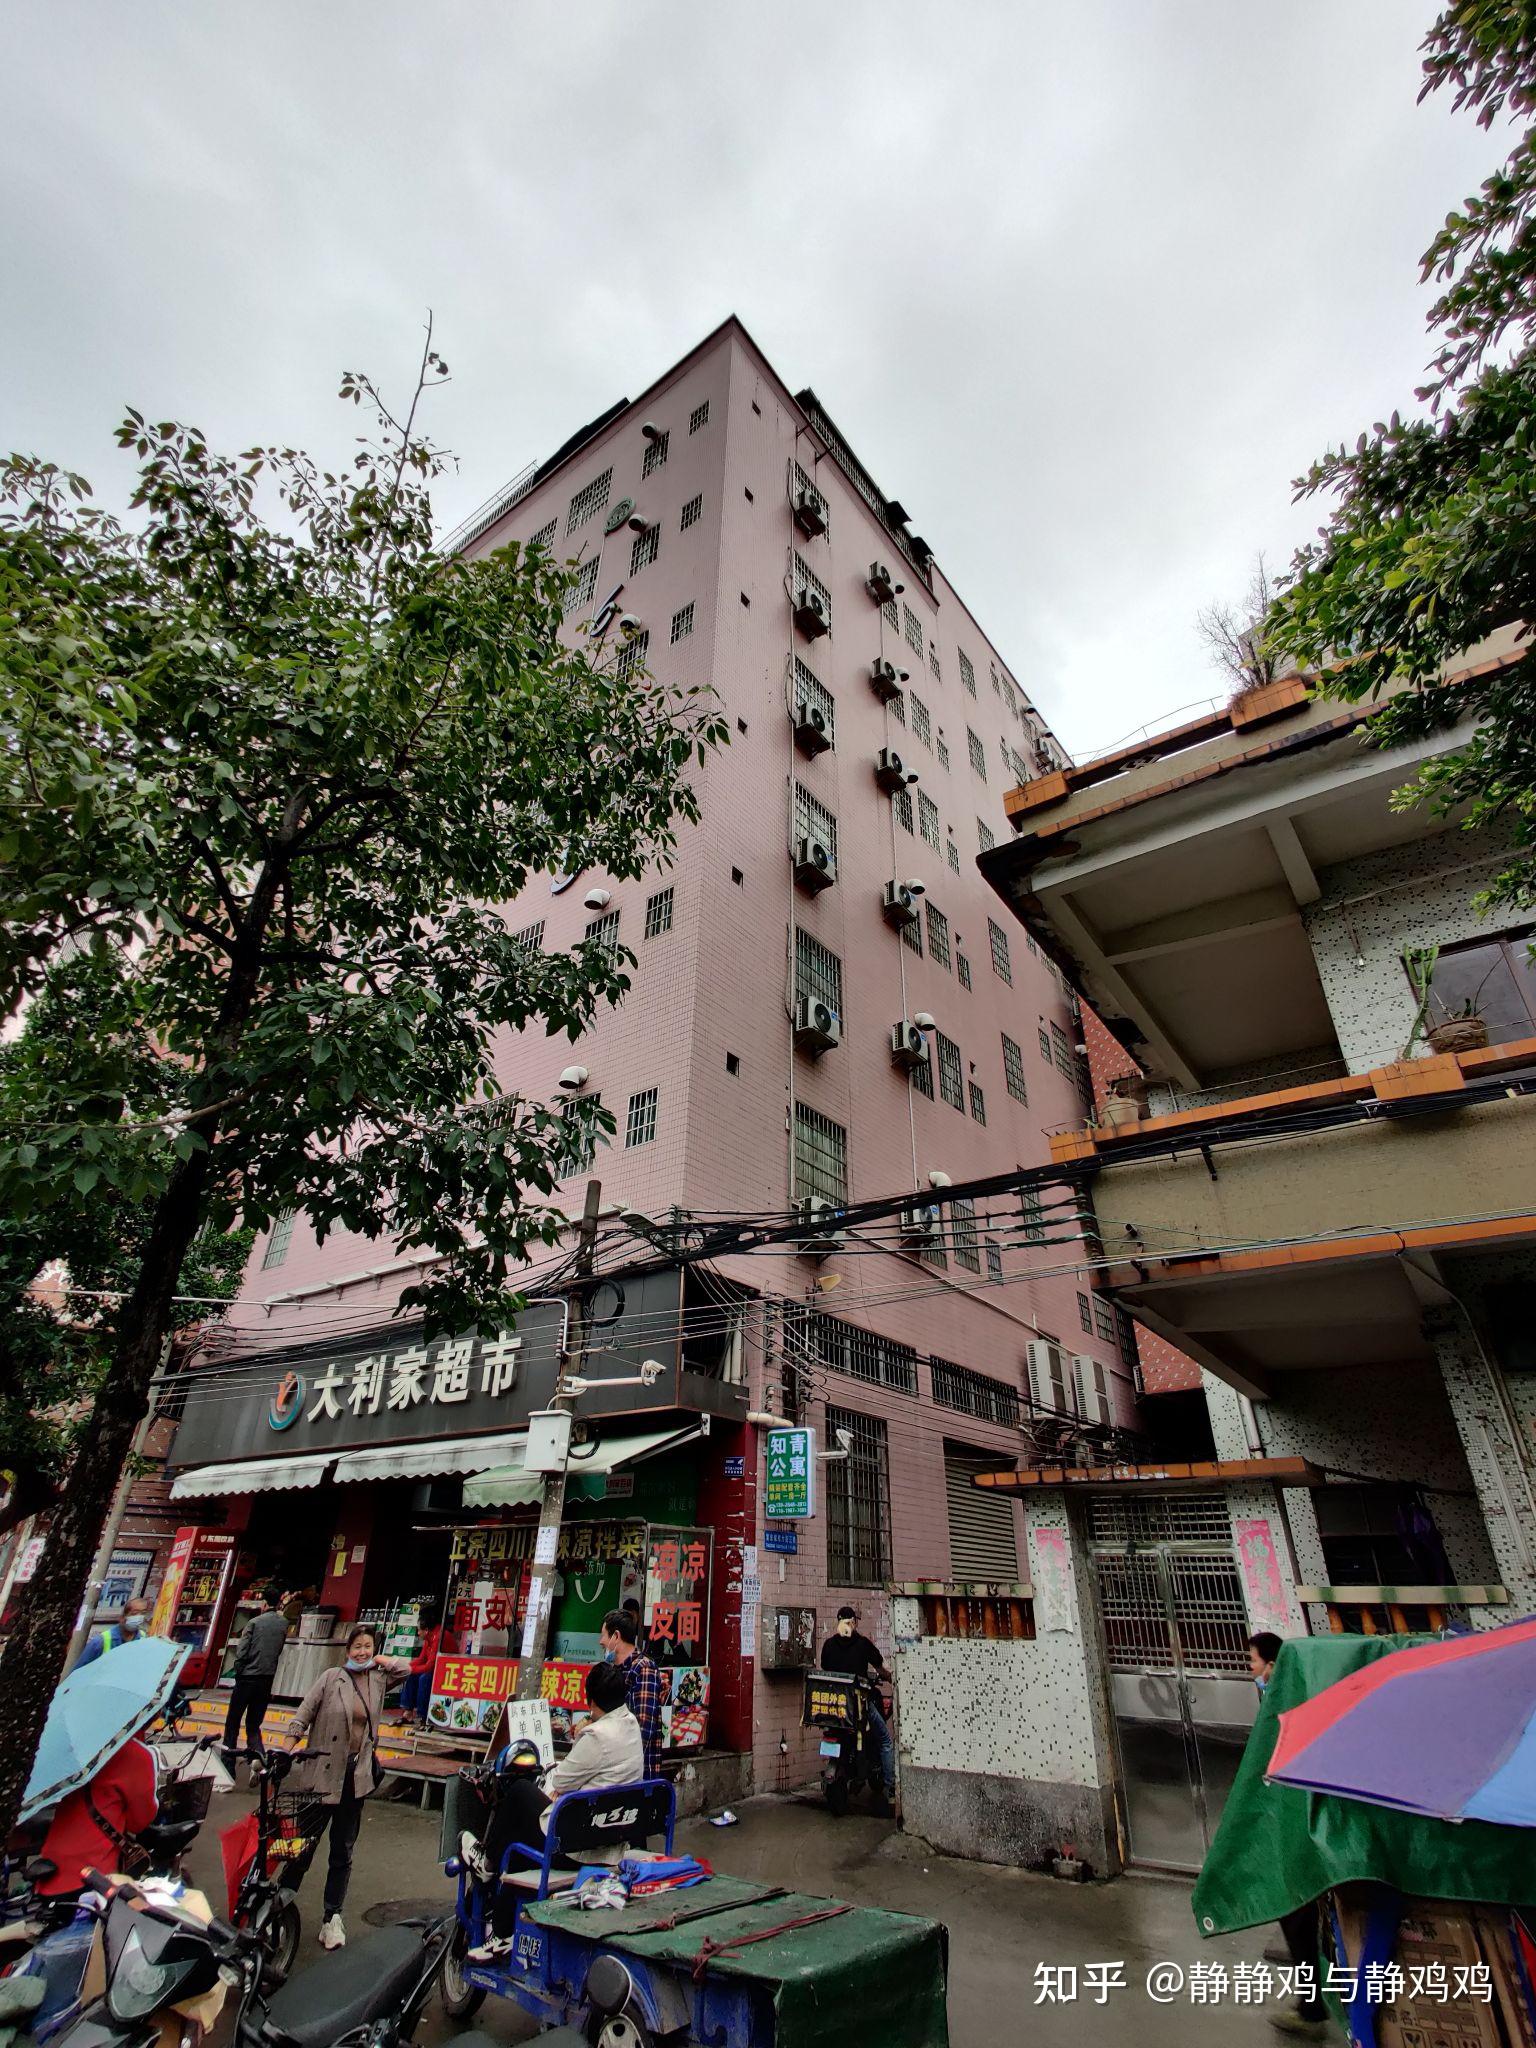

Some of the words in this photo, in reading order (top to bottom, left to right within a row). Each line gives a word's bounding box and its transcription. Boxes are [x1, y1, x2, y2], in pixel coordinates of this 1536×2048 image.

[307, 1331, 523, 1423] 大利家超市
[812, 1691, 847, 1706] 美团外卖
[519, 1718, 542, 1739] 单间
